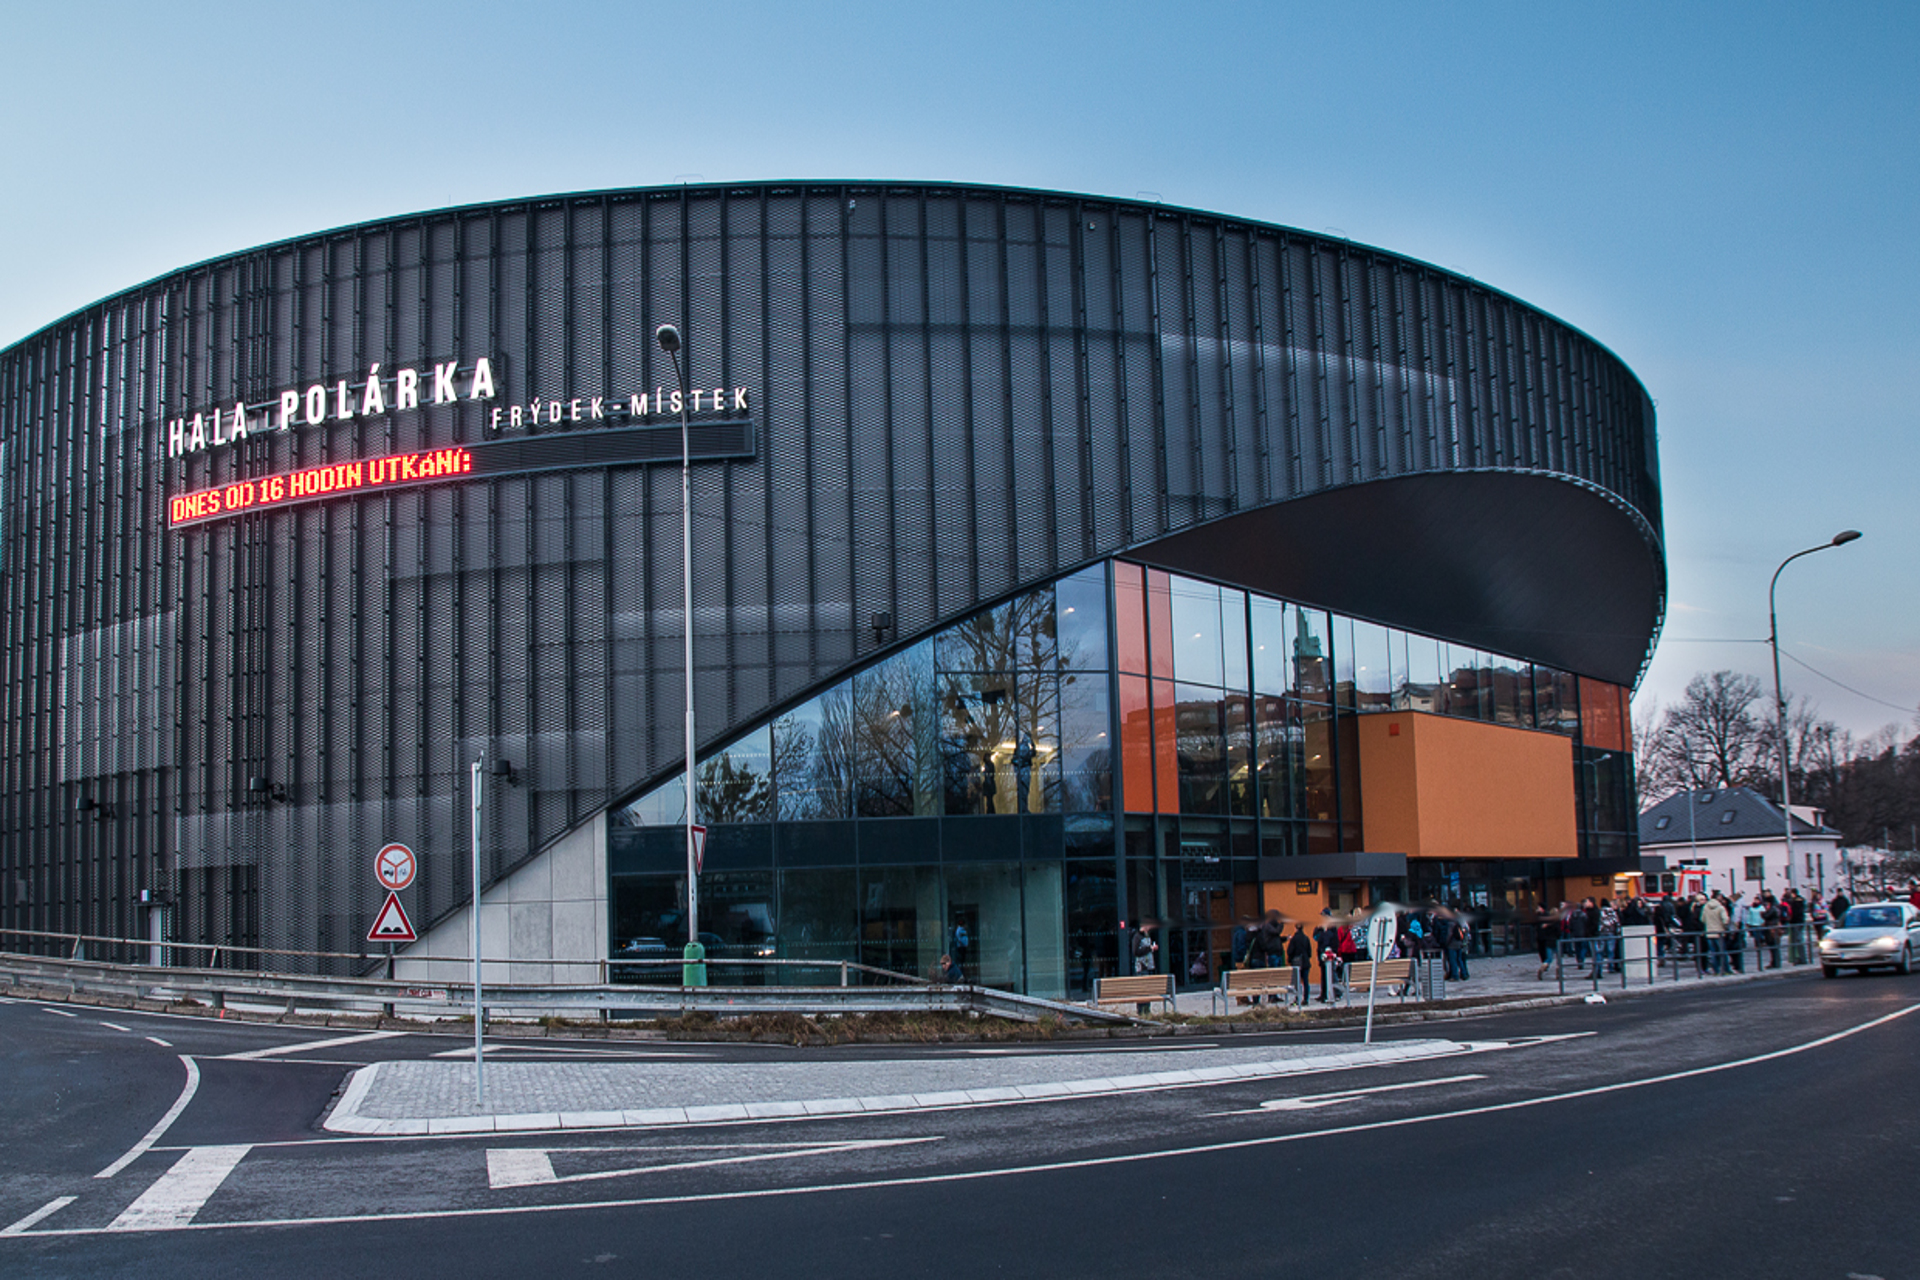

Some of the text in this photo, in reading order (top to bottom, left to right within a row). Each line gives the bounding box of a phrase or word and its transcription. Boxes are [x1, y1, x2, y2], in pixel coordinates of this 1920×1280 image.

[169, 357, 495, 457] HALA POLÁRKA
[171, 491, 220, 522] DNES
[225, 483, 254, 509] OD
[260, 477, 284, 502] 16
[290, 463, 361, 497] HODIN
